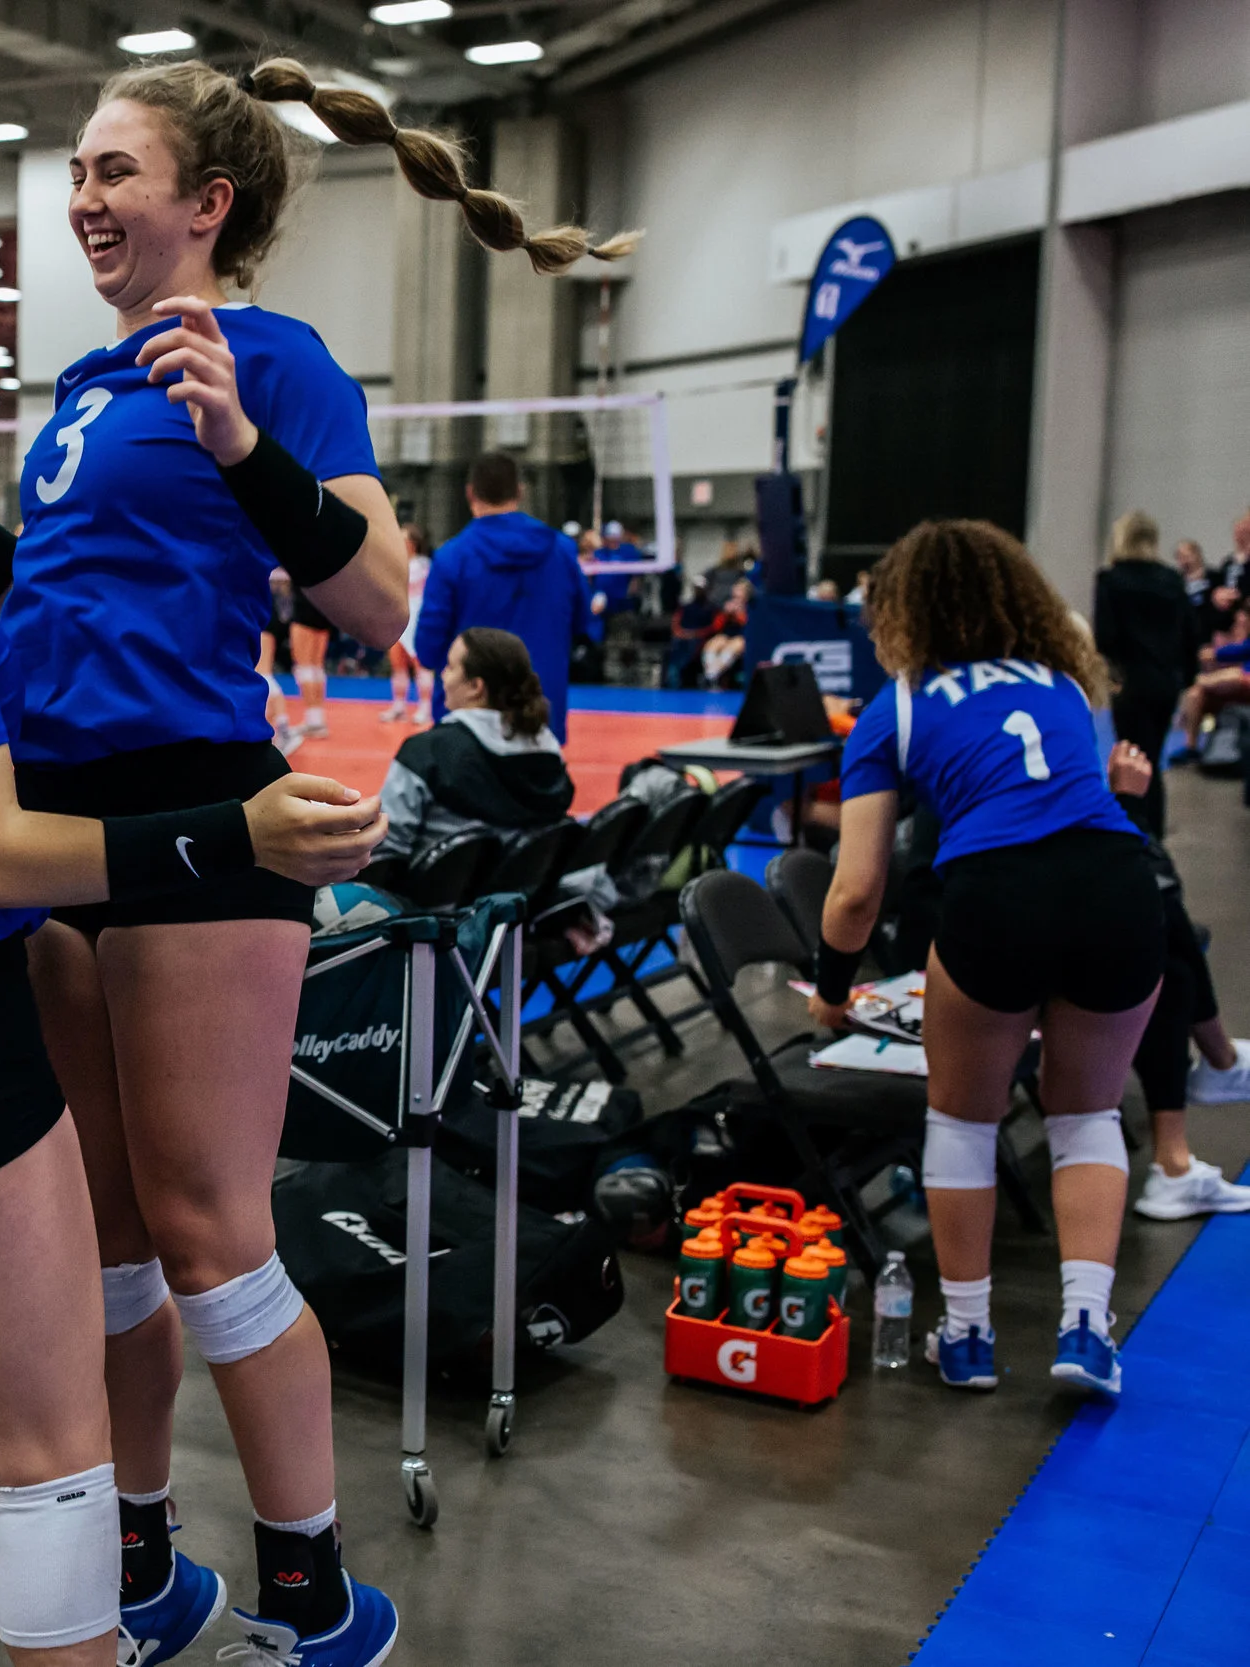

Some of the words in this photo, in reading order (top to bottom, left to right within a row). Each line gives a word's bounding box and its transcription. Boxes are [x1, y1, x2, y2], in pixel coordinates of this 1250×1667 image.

[35, 387, 113, 505] 3
[924, 657, 1055, 707] TAV
[1002, 710, 1050, 781] 1
[682, 1277, 707, 1308] G
[743, 1288, 771, 1319] G
[780, 1296, 805, 1328] G
[717, 1338, 758, 1384] G
